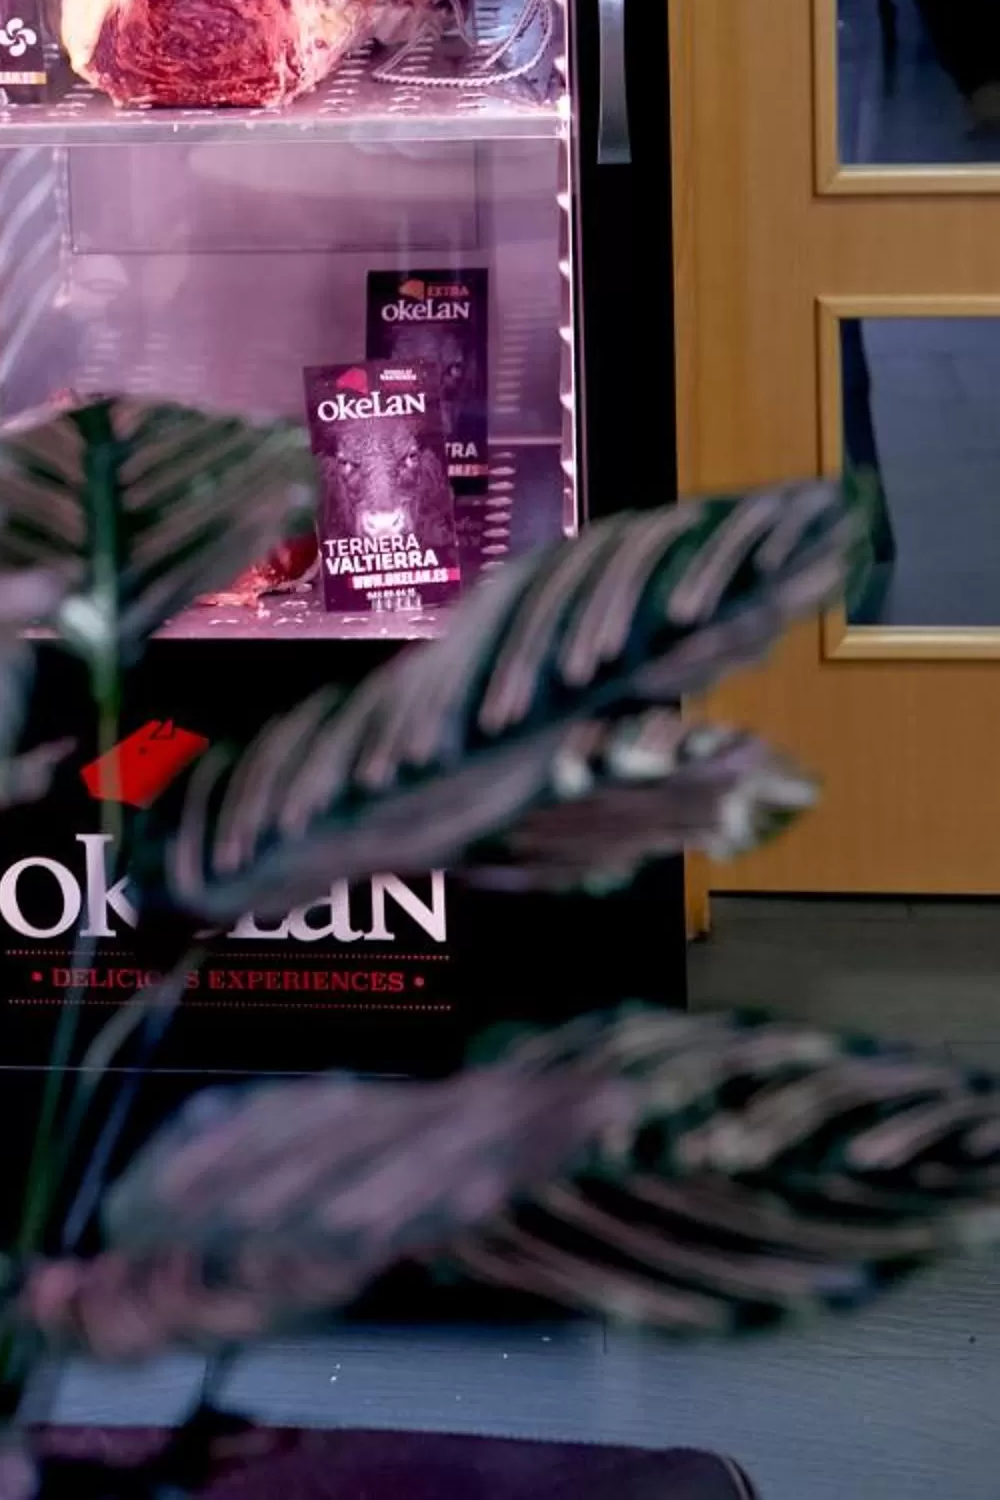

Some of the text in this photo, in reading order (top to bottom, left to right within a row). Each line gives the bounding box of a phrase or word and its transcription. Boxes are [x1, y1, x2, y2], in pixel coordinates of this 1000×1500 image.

[324, 533, 421, 558] TERNERA
[325, 548, 439, 576] VALTIERRA
[208, 969, 405, 992] EXPERIENCES
